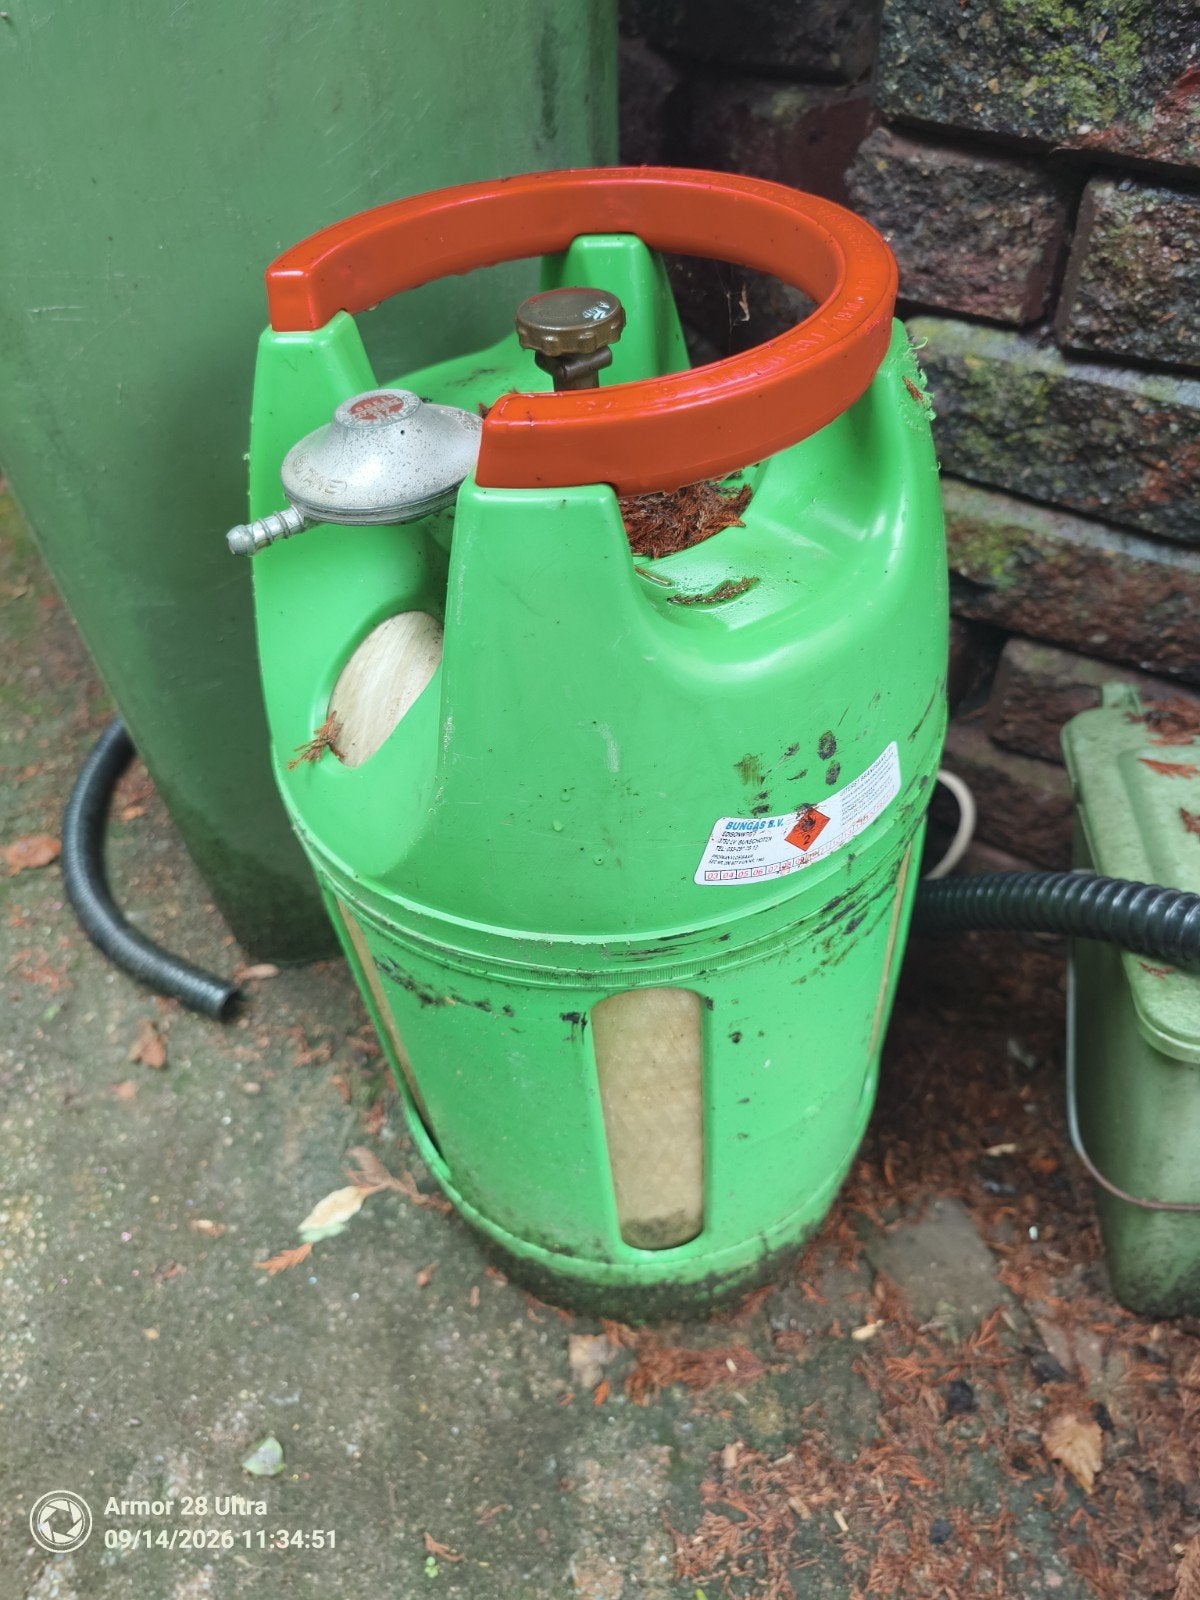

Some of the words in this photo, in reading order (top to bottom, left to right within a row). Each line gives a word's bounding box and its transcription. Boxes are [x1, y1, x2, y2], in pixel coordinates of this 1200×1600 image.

[725, 820, 766, 831] BUNGAS
[767, 819, 784, 829] B.V.
[803, 834, 811, 845] 2
[707, 872, 719, 880] 03
[722, 871, 734, 879] 04
[737, 870, 749, 878] 05
[752, 868, 764, 876] 06
[767, 865, 779, 873] 07
